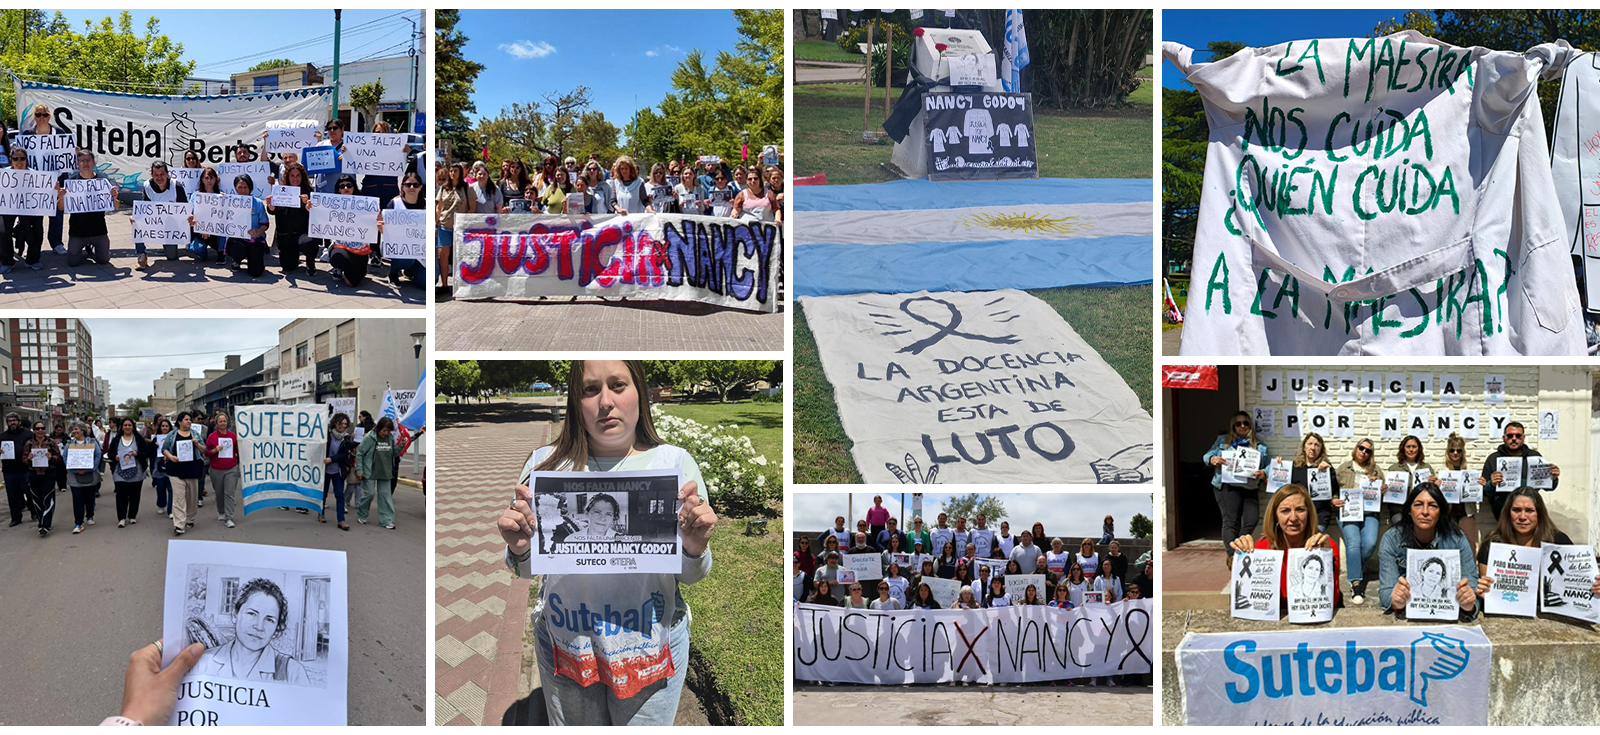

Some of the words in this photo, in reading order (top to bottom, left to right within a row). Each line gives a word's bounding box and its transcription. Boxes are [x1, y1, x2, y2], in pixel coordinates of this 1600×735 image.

[1275, 38, 1326, 85] LA
[1344, 37, 1475, 104] MAESTRA
[924, 94, 973, 111] NANCY
[982, 94, 1026, 111] GODOY
[53, 107, 161, 158] Suteba
[280, 130, 296, 138] POR
[1241, 96, 1309, 161] NOS
[1324, 106, 1434, 163] CUIDA
[16, 135, 37, 150] NOS
[40, 134, 75, 150] FALTA
[346, 135, 367, 145] NOS
[356, 149, 377, 157] UNA
[218, 164, 266, 175] JUSTICIA
[346, 161, 405, 172] MAESTRA
[0, 171, 19, 189] OS
[22, 173, 53, 189] FALTA
[65, 181, 85, 193] NOS
[86, 179, 111, 193] FALTA
[1352, 158, 1460, 221] CUIDA
[10, 192, 56, 210] MAESTRA
[66, 195, 84, 212] UNA
[134, 204, 154, 216] NOS
[155, 204, 188, 216] FALTA
[210, 208, 235, 220] POR
[328, 210, 356, 224] POR
[145, 217, 164, 225] UNA
[385, 211, 419, 227] NOS
[134, 229, 188, 240] MAESTRA
[195, 221, 248, 238] NANCY
[311, 223, 369, 240] NANCY
[665, 219, 777, 304] NANCY
[1205, 251, 1232, 316] A
[1250, 266, 1301, 319] LA
[857, 361, 911, 382] LA
[933, 351, 1086, 375] DOCENCIA
[897, 371, 1076, 403] ARGENTINA
[1266, 378, 1457, 396] JUSTICIA
[937, 403, 1009, 423] ESTA
[1022, 399, 1067, 414] DE
[236, 410, 325, 440] SUTEBA
[1287, 414, 1351, 429] POR
[1384, 415, 1507, 432] NANCY
[252, 441, 308, 461] MONTE
[921, 421, 1076, 466] LUTO
[242, 462, 322, 485] HERMOSO
[563, 481, 586, 492] NOS
[586, 481, 616, 491] FALTA
[616, 480, 652, 491] NANCY
[554, 543, 591, 554] JUSTICIA
[591, 543, 611, 554] POR
[610, 543, 641, 554] NANCY
[641, 542, 674, 554] GODOY
[576, 558, 607, 566] SUTECO
[1493, 559, 1506, 568] PARO
[1507, 562, 1533, 571] NACIONAL
[1250, 592, 1274, 600] NANCY
[1563, 590, 1595, 601] NANCY
[548, 592, 641, 638] Suteba
[796, 607, 954, 674] JUSTICIA
[953, 620, 990, 676] X
[997, 614, 1121, 674] NANCY
[1223, 639, 1405, 705] Suteba
[177, 680, 271, 708] JUSTICIA
[177, 709, 219, 726] POR
